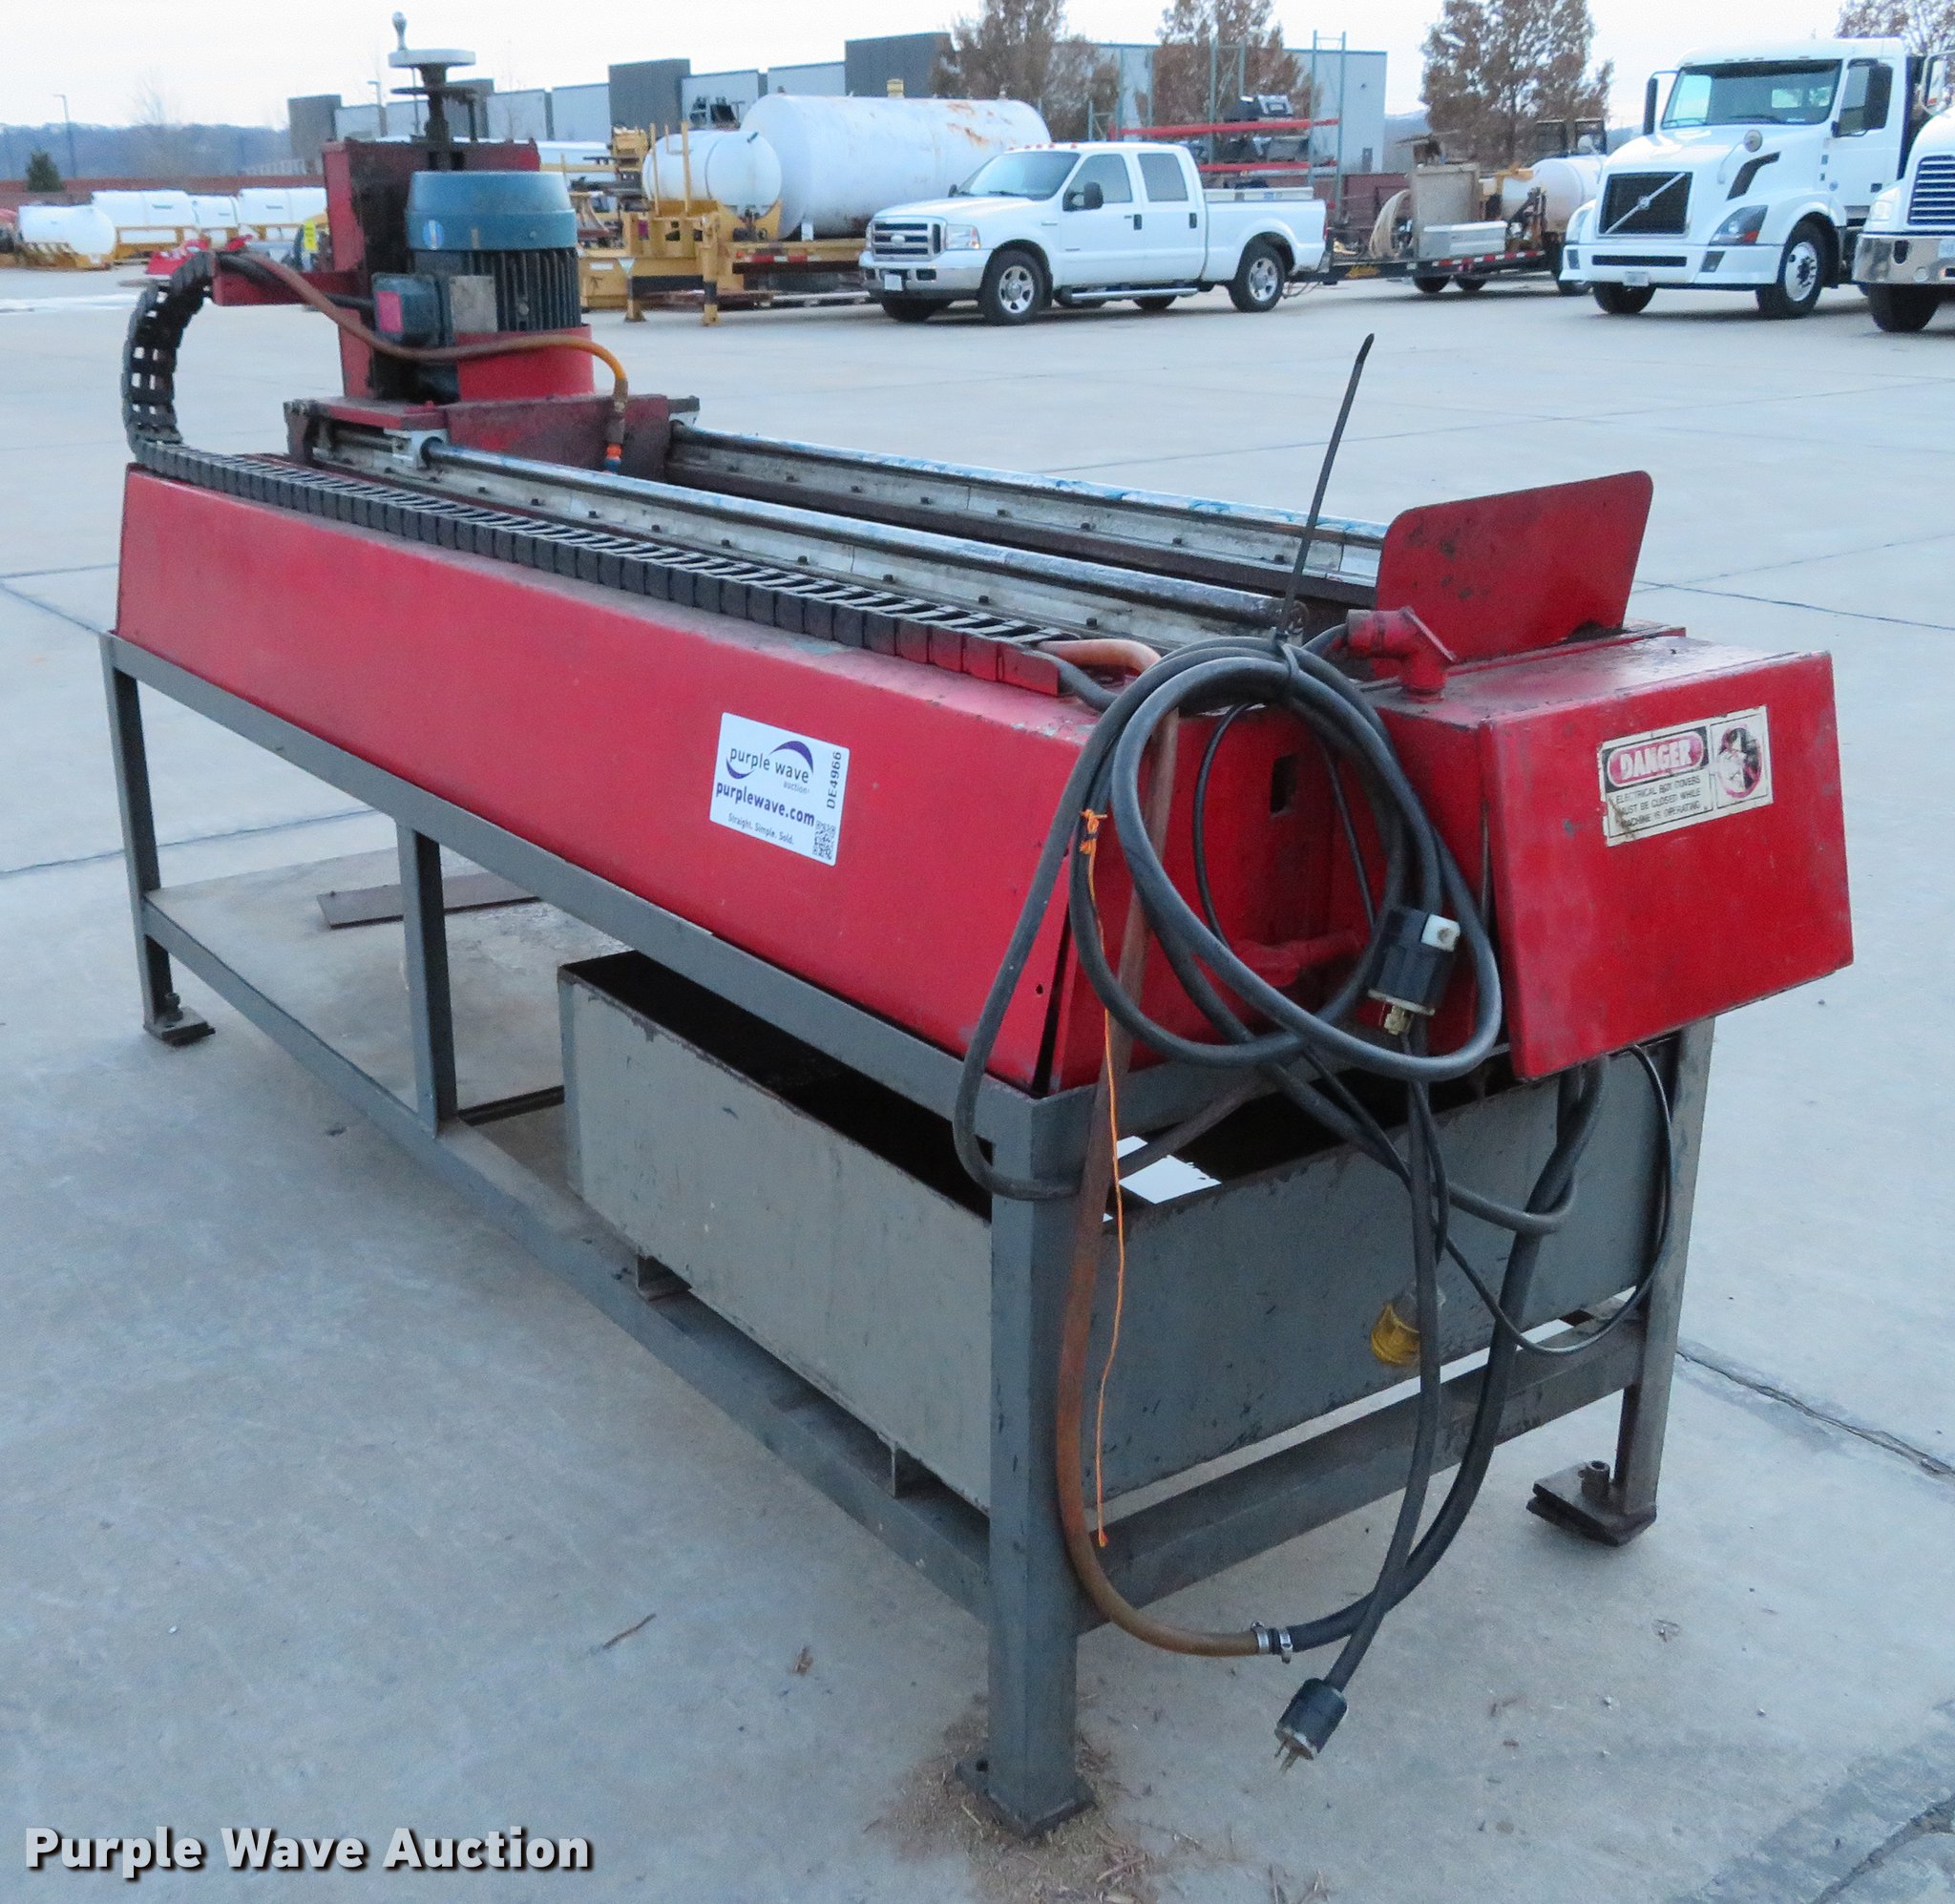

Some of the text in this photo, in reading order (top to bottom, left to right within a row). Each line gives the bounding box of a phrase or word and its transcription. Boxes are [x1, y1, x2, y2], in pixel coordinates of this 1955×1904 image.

[730, 748, 809, 784] purple wave
[1619, 739, 1692, 781] DANGER
[827, 751, 842, 809] DE4966
[1616, 787, 1657, 805] ELECTRICAL
[1674, 775, 1701, 788] COVERS
[716, 782, 815, 826] purplewave.com
[1640, 801, 1650, 811] BE
[1650, 793, 1678, 808] CLOSED
[1679, 787, 1701, 800] WHILE
[1653, 810, 1661, 819] IS
[1663, 800, 1701, 817] OPERATING
[728, 813, 795, 846] Straight. Simple. Sold.
